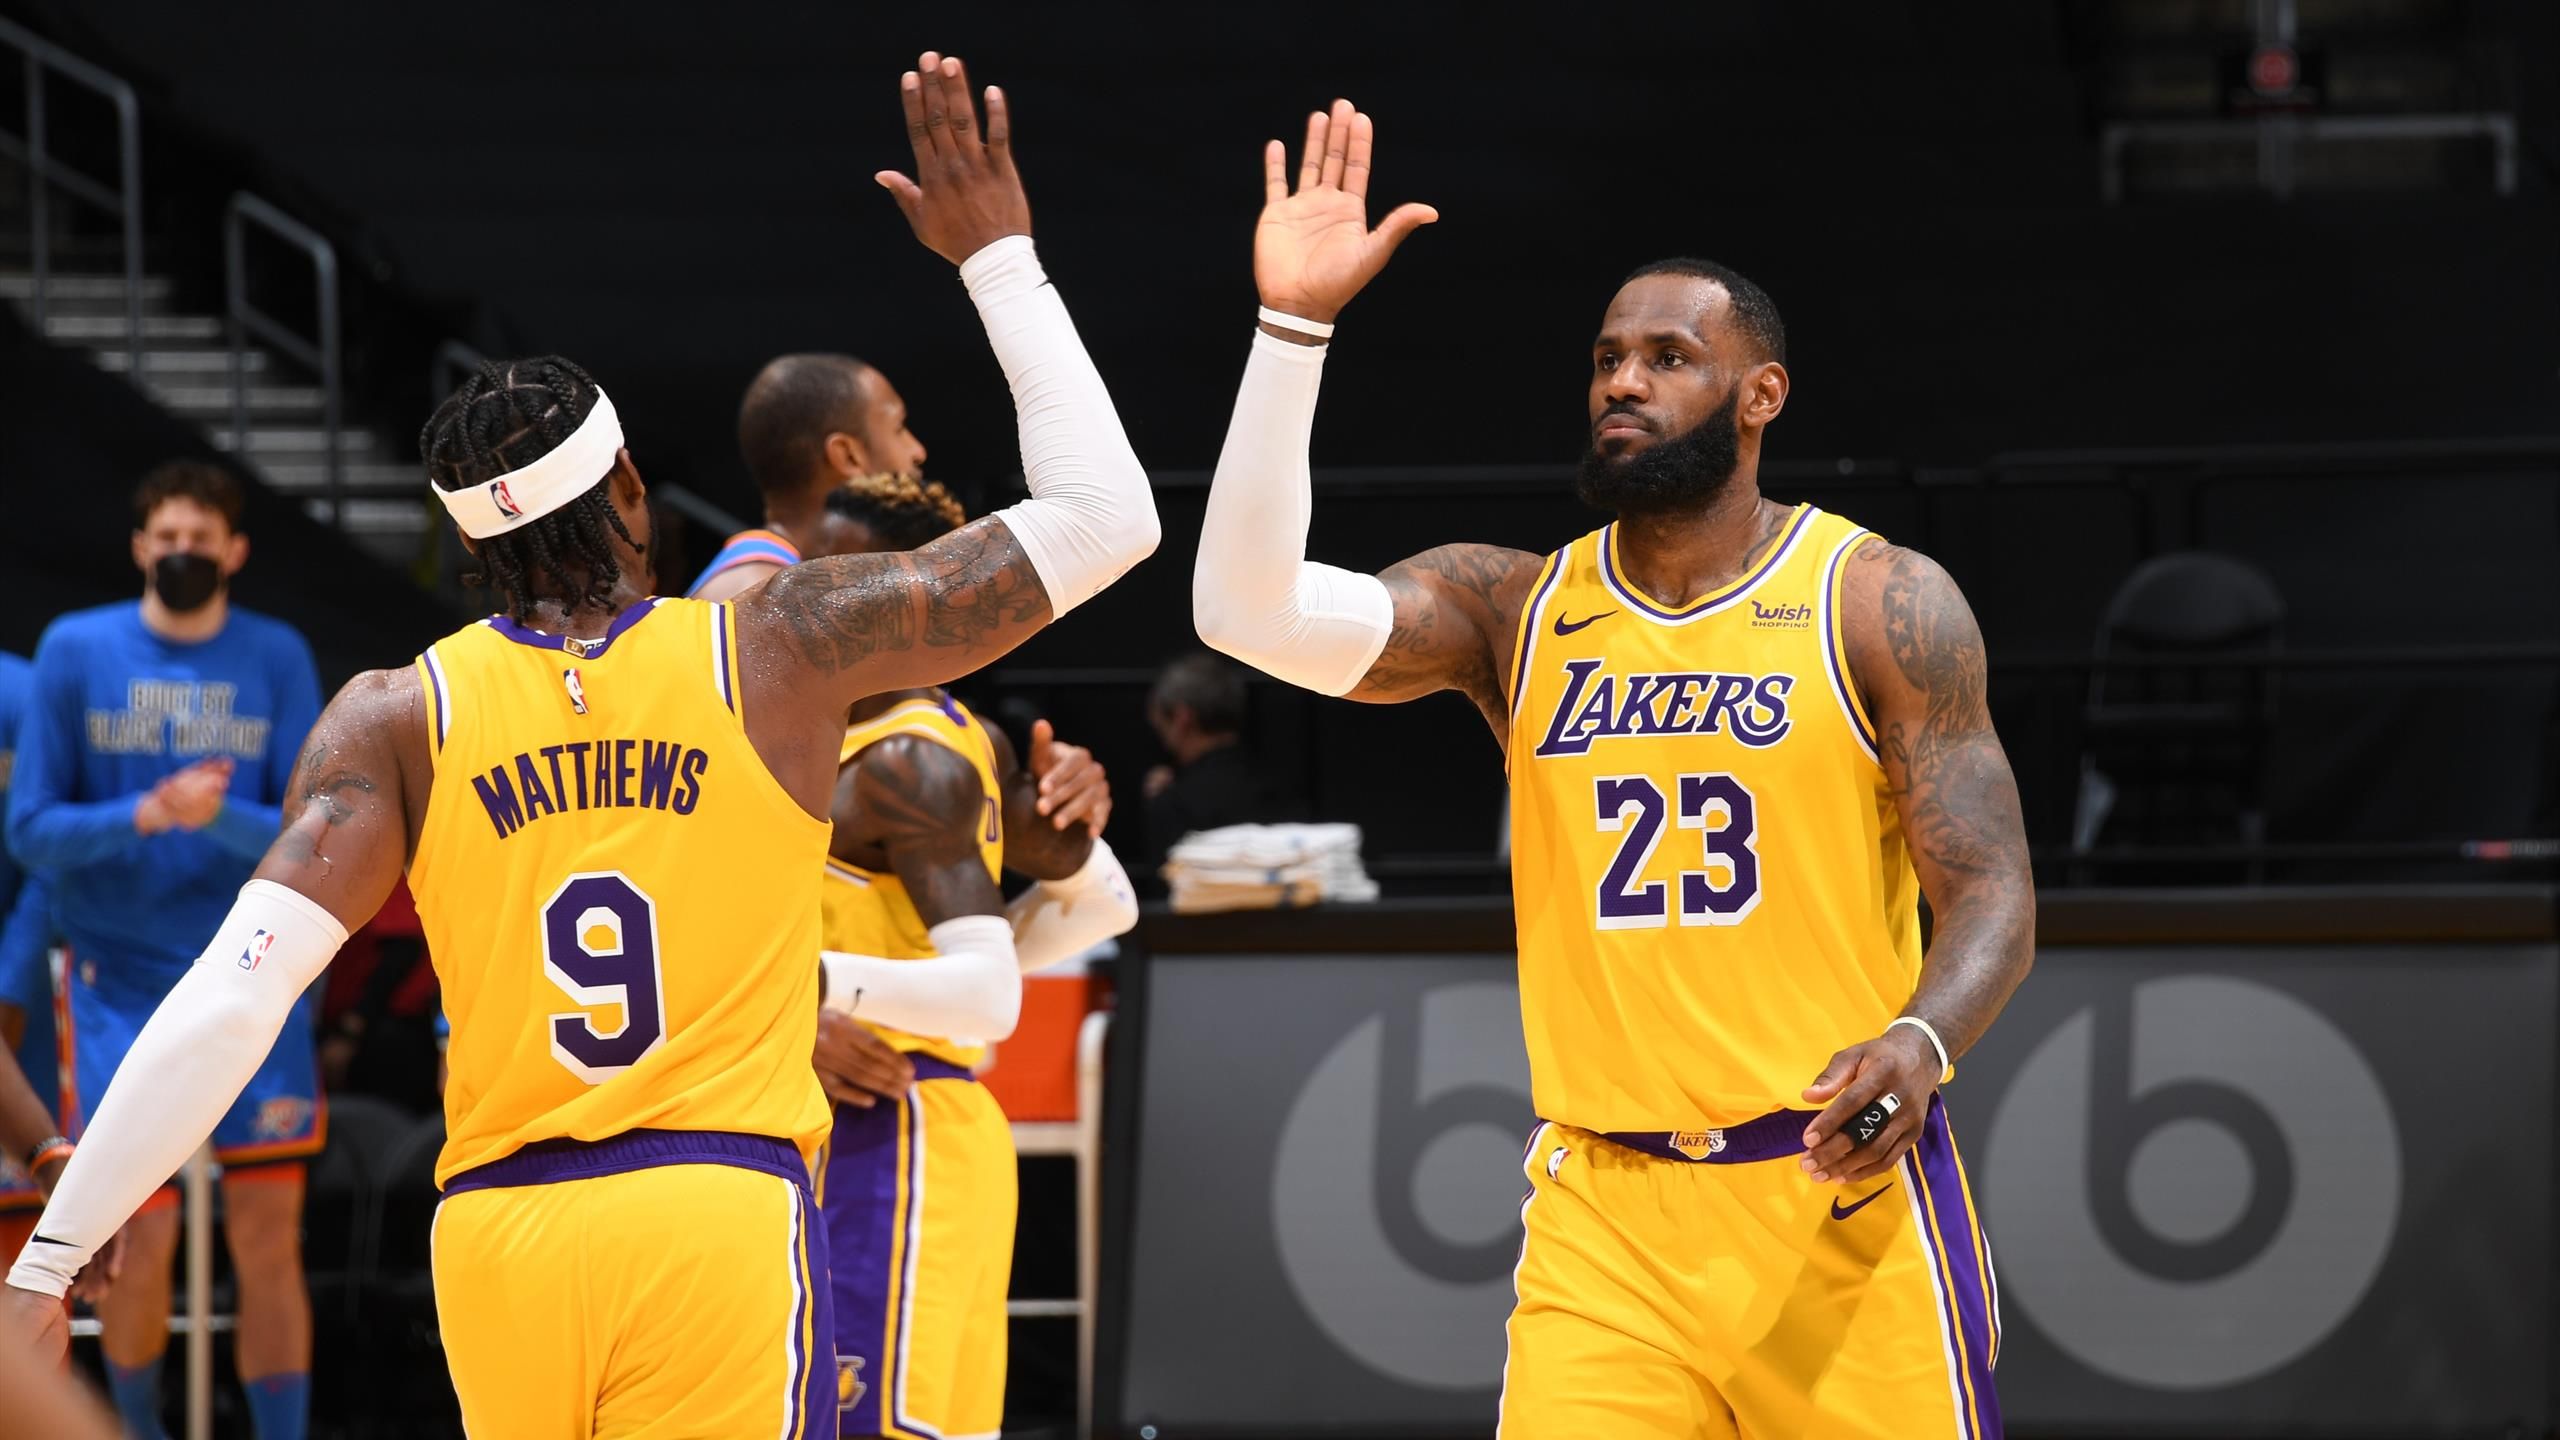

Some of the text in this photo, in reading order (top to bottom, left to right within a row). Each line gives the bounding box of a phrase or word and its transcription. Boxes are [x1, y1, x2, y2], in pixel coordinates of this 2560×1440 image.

[1751, 620, 1809, 628] SHOPPING
[1534, 657, 1797, 759] LAKERS
[471, 738, 709, 840] MATTHEWS
[1593, 772, 1762, 930] 23
[540, 870, 667, 1086] 9
[1671, 1131, 1725, 1151] LAKERS
[1860, 1110, 1882, 1141] 24
